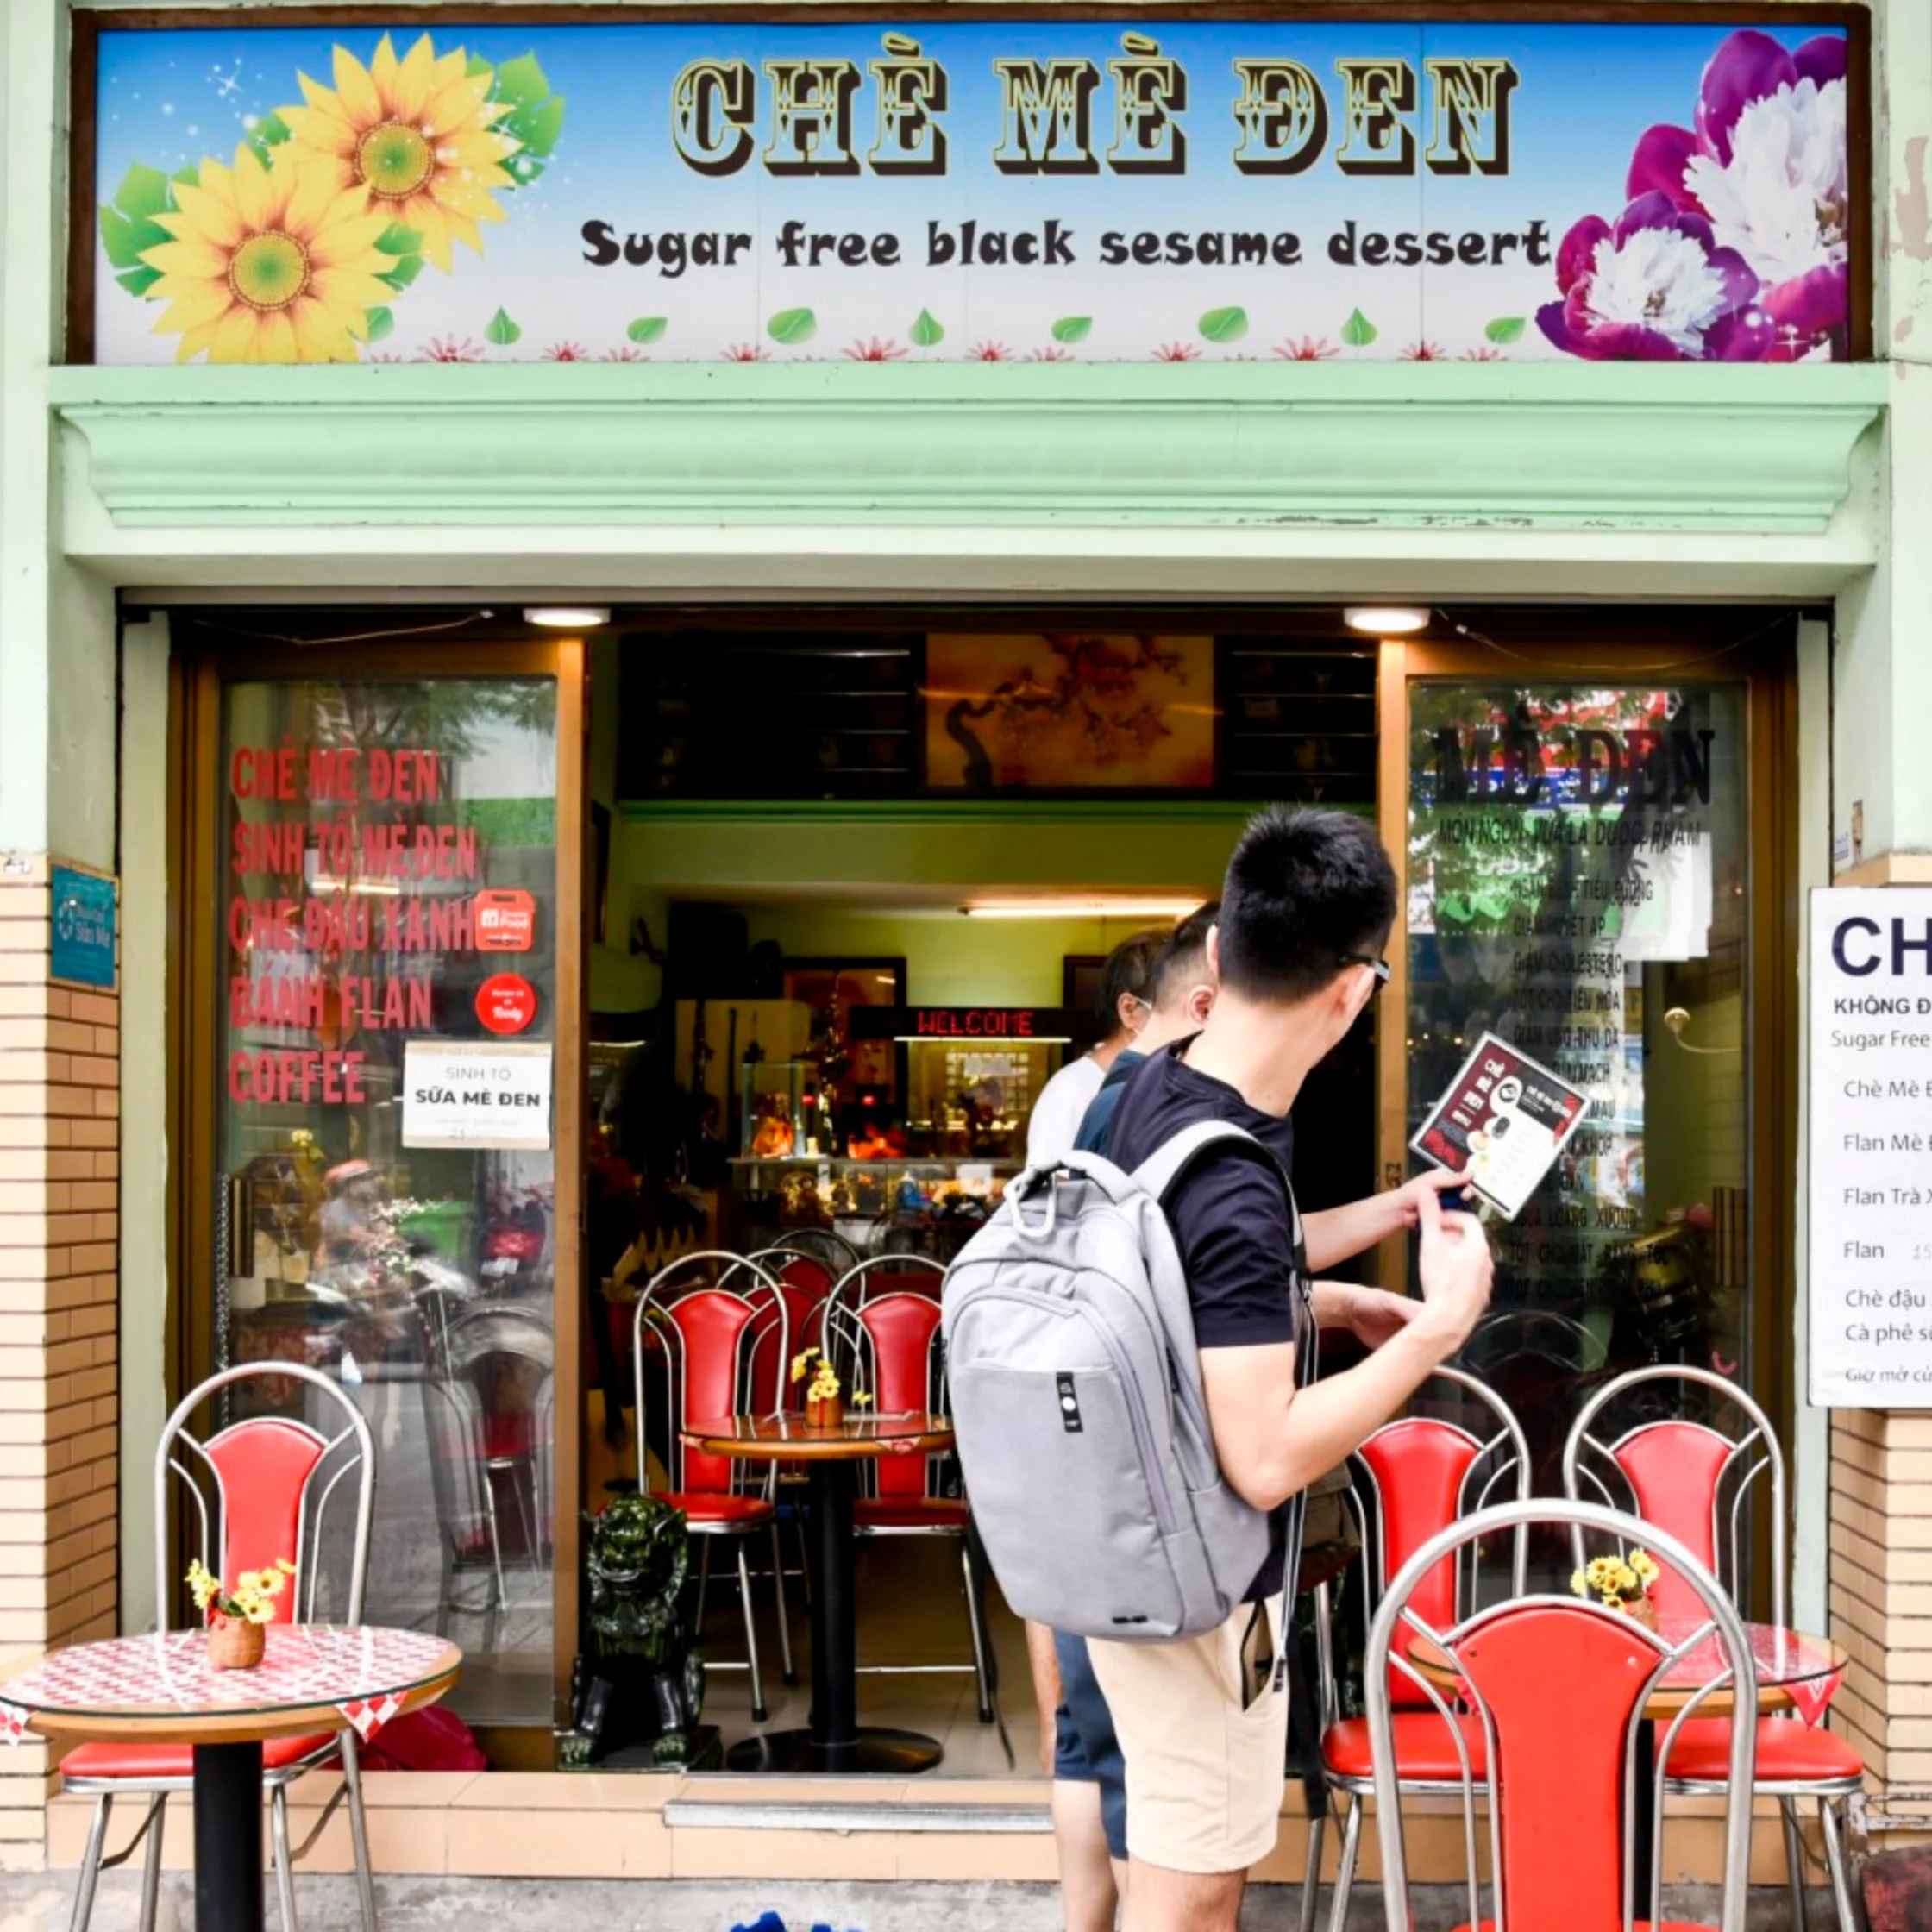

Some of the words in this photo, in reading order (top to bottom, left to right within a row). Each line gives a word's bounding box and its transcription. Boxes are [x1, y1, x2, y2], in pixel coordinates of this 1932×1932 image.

[671, 32, 949, 176] CHÈ
[992, 32, 1187, 176] MÈ
[1232, 57, 1521, 176] ĐEN
[580, 219, 753, 278] Sugar
[775, 219, 901, 267] free
[926, 218, 1076, 267] black
[1099, 223, 1303, 267] sesame
[1326, 218, 1552, 267] dessert
[369, 748, 438, 803] ĐEN
[232, 820, 304, 875] SINH
[416, 824, 479, 881] ĐEN
[381, 896, 478, 951] XANH
[1832, 917, 1932, 976] CH
[341, 975, 431, 1029] FLAN
[1834, 994, 1910, 1016] KHÔNG
[918, 1009, 1033, 1035] WELCOME
[1831, 1030, 1885, 1051] Sugar
[1891, 1030, 1930, 1048] Free
[229, 1050, 366, 1105] COFFEE
[446, 1066, 486, 1081] SINH
[415, 1085, 457, 1106] SỮA
[498, 1092, 541, 1107] ĐEN
[1843, 1078, 1883, 1099] Chè
[1888, 1078, 1920, 1099] Mè
[1843, 1132, 1885, 1152] Flan
[1891, 1132, 1923, 1152] Mè
[1843, 1187, 1885, 1205] Flan
[1890, 1187, 1922, 1205] Trà
[1843, 1241, 1885, 1259] Flan
[1846, 1289, 1883, 1308] Chè
[1889, 1289, 1926, 1311] đậu
[1846, 1324, 1870, 1341] Cà
[1876, 1322, 1914, 1346] phê
